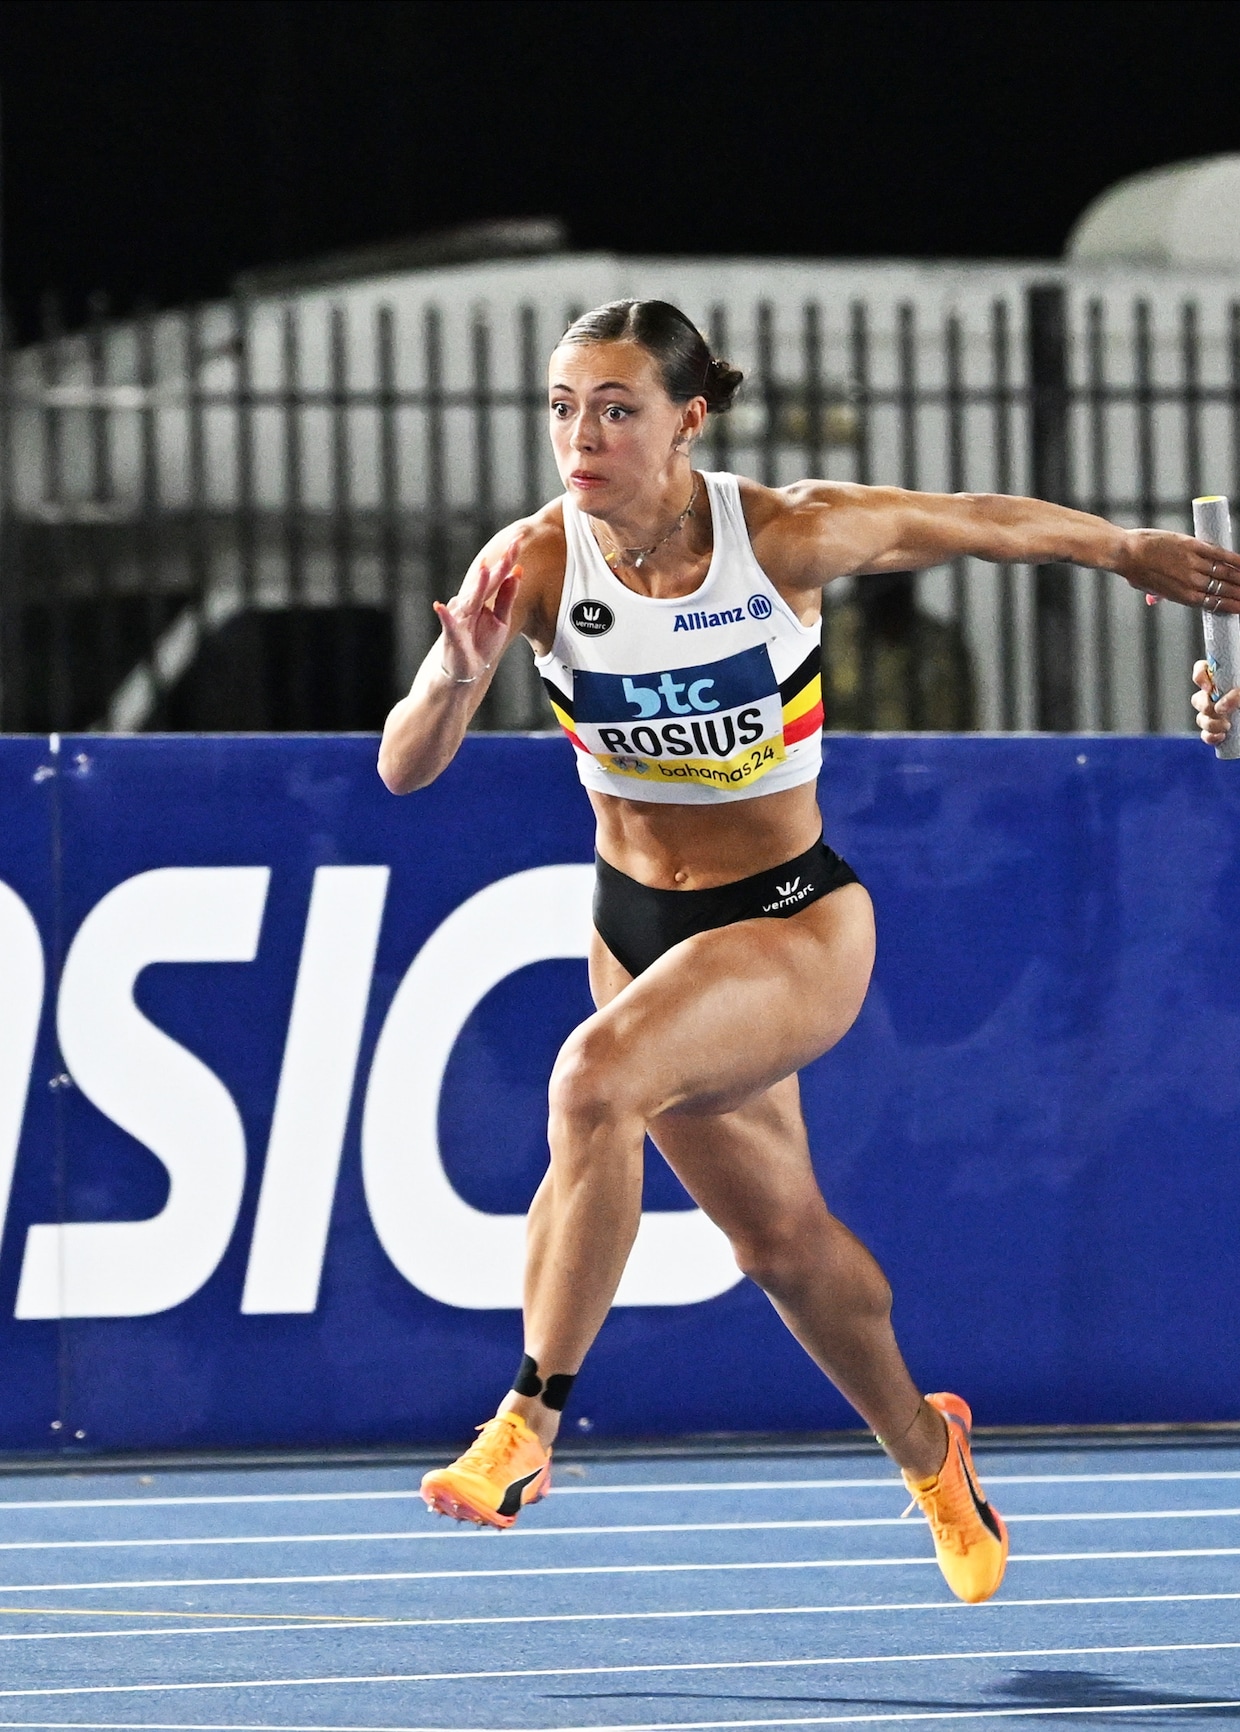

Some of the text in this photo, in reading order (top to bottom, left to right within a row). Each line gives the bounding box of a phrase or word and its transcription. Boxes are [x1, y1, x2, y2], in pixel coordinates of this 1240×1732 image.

[575, 620, 607, 630] vermarc
[673, 607, 746, 632] Allianz
[1203, 608, 1215, 640] baha
[622, 673, 720, 718] btc
[598, 708, 764, 757] ROSIUS
[762, 883, 815, 912] vermarc
[0, 864, 749, 1320] SIC
